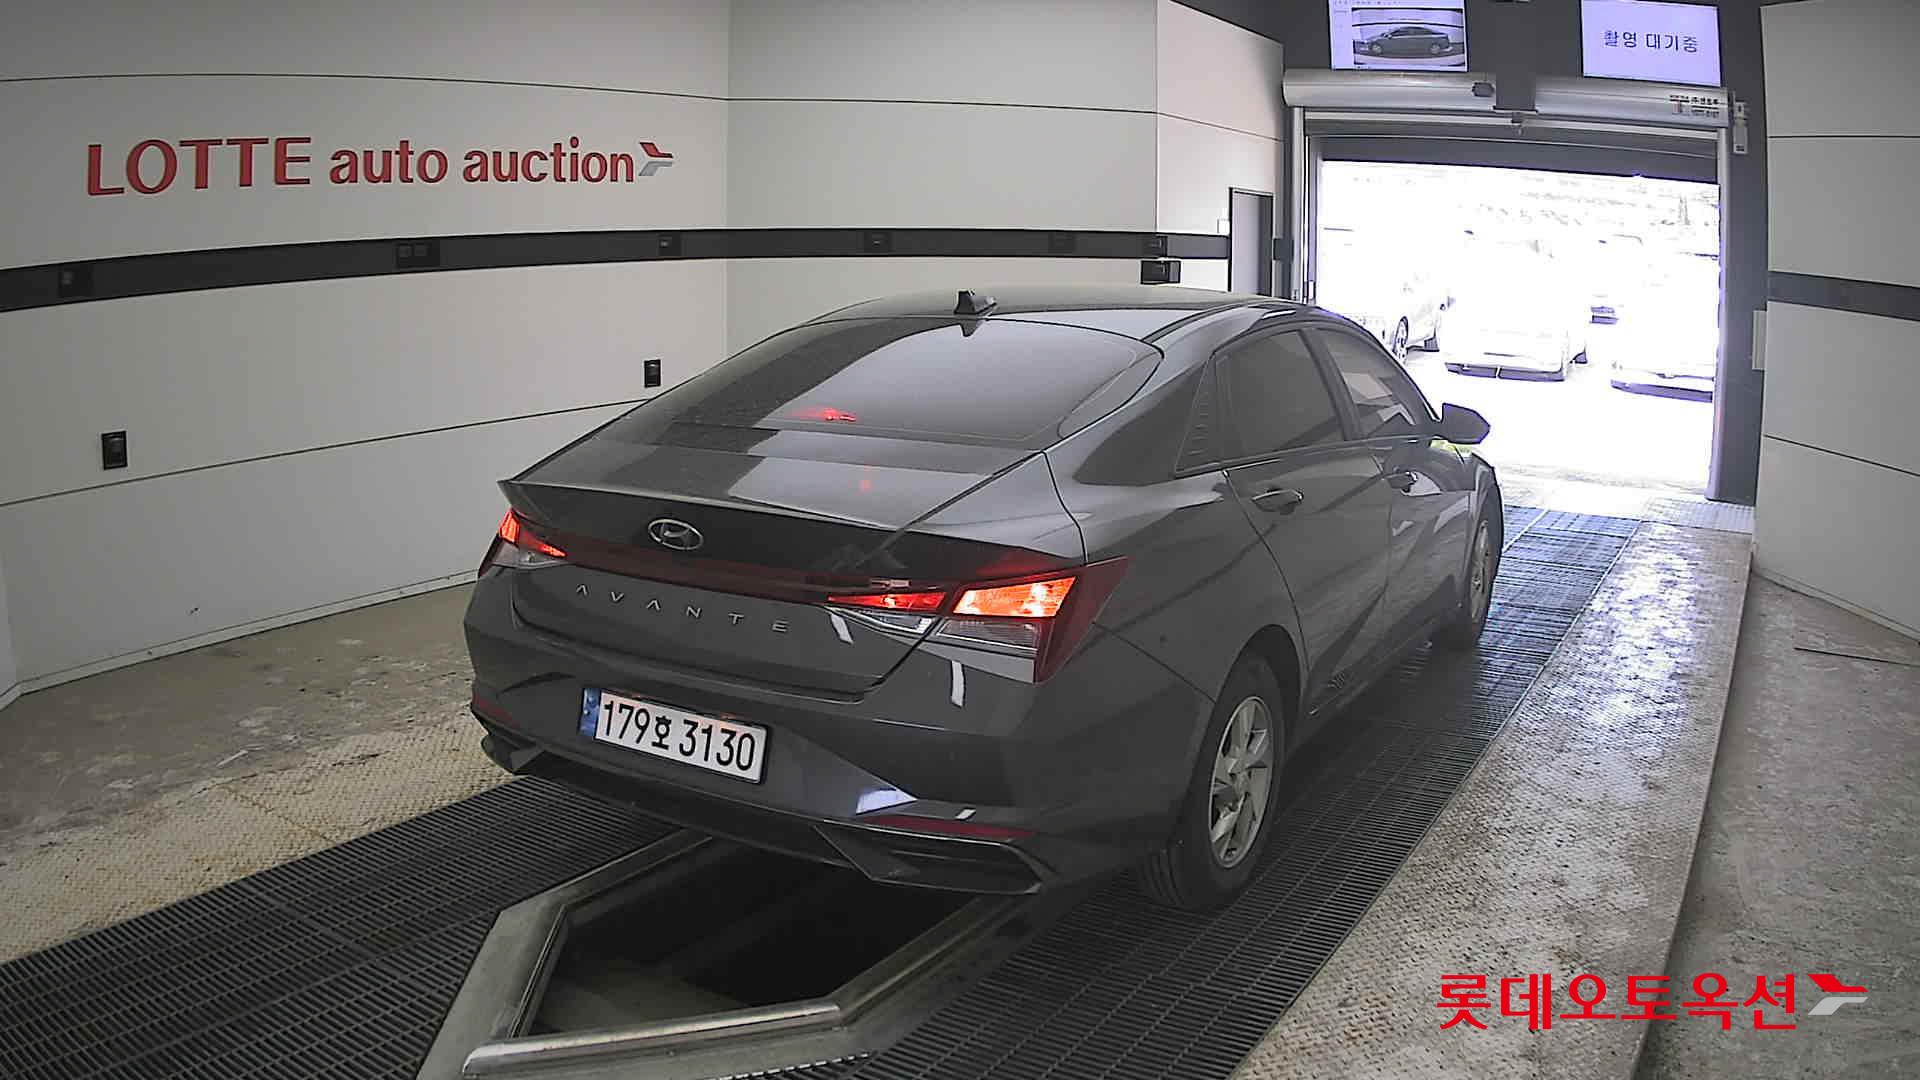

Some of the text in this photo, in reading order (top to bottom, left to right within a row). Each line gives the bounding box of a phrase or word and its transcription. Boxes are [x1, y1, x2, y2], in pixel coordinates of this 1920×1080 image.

[1645, 32, 1698, 53] 대기중
[86, 136, 635, 197] LOTTE auto auction
[575, 582, 791, 633] AVANTE
[602, 699, 756, 771] 179호 3130
